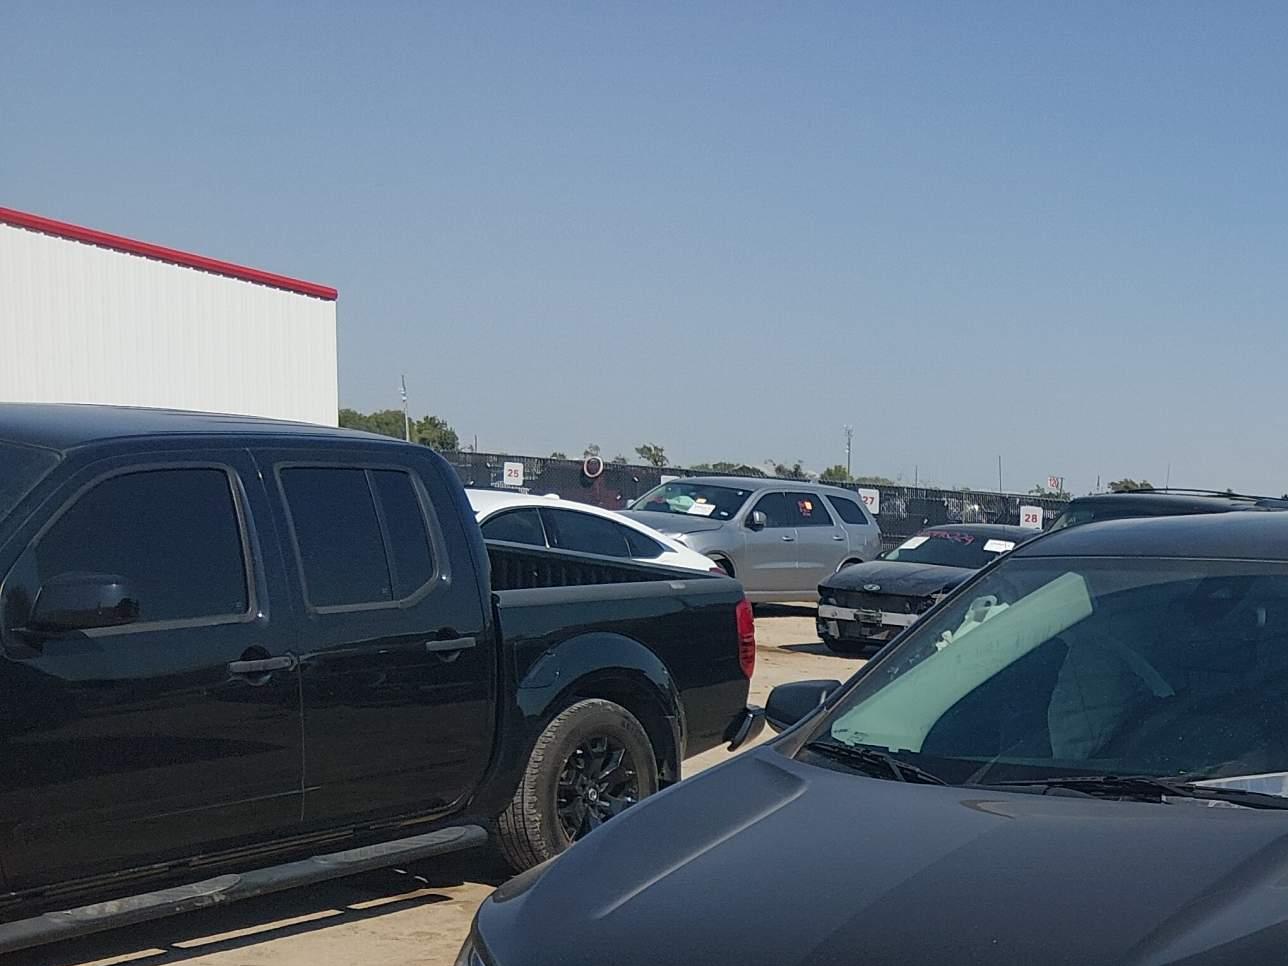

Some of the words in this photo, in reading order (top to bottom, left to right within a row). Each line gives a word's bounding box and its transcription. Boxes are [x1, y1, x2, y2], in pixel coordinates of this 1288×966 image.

[507, 468, 519, 478] 25
[862, 495, 875, 505] 27
[1024, 513, 1038, 523] 28
